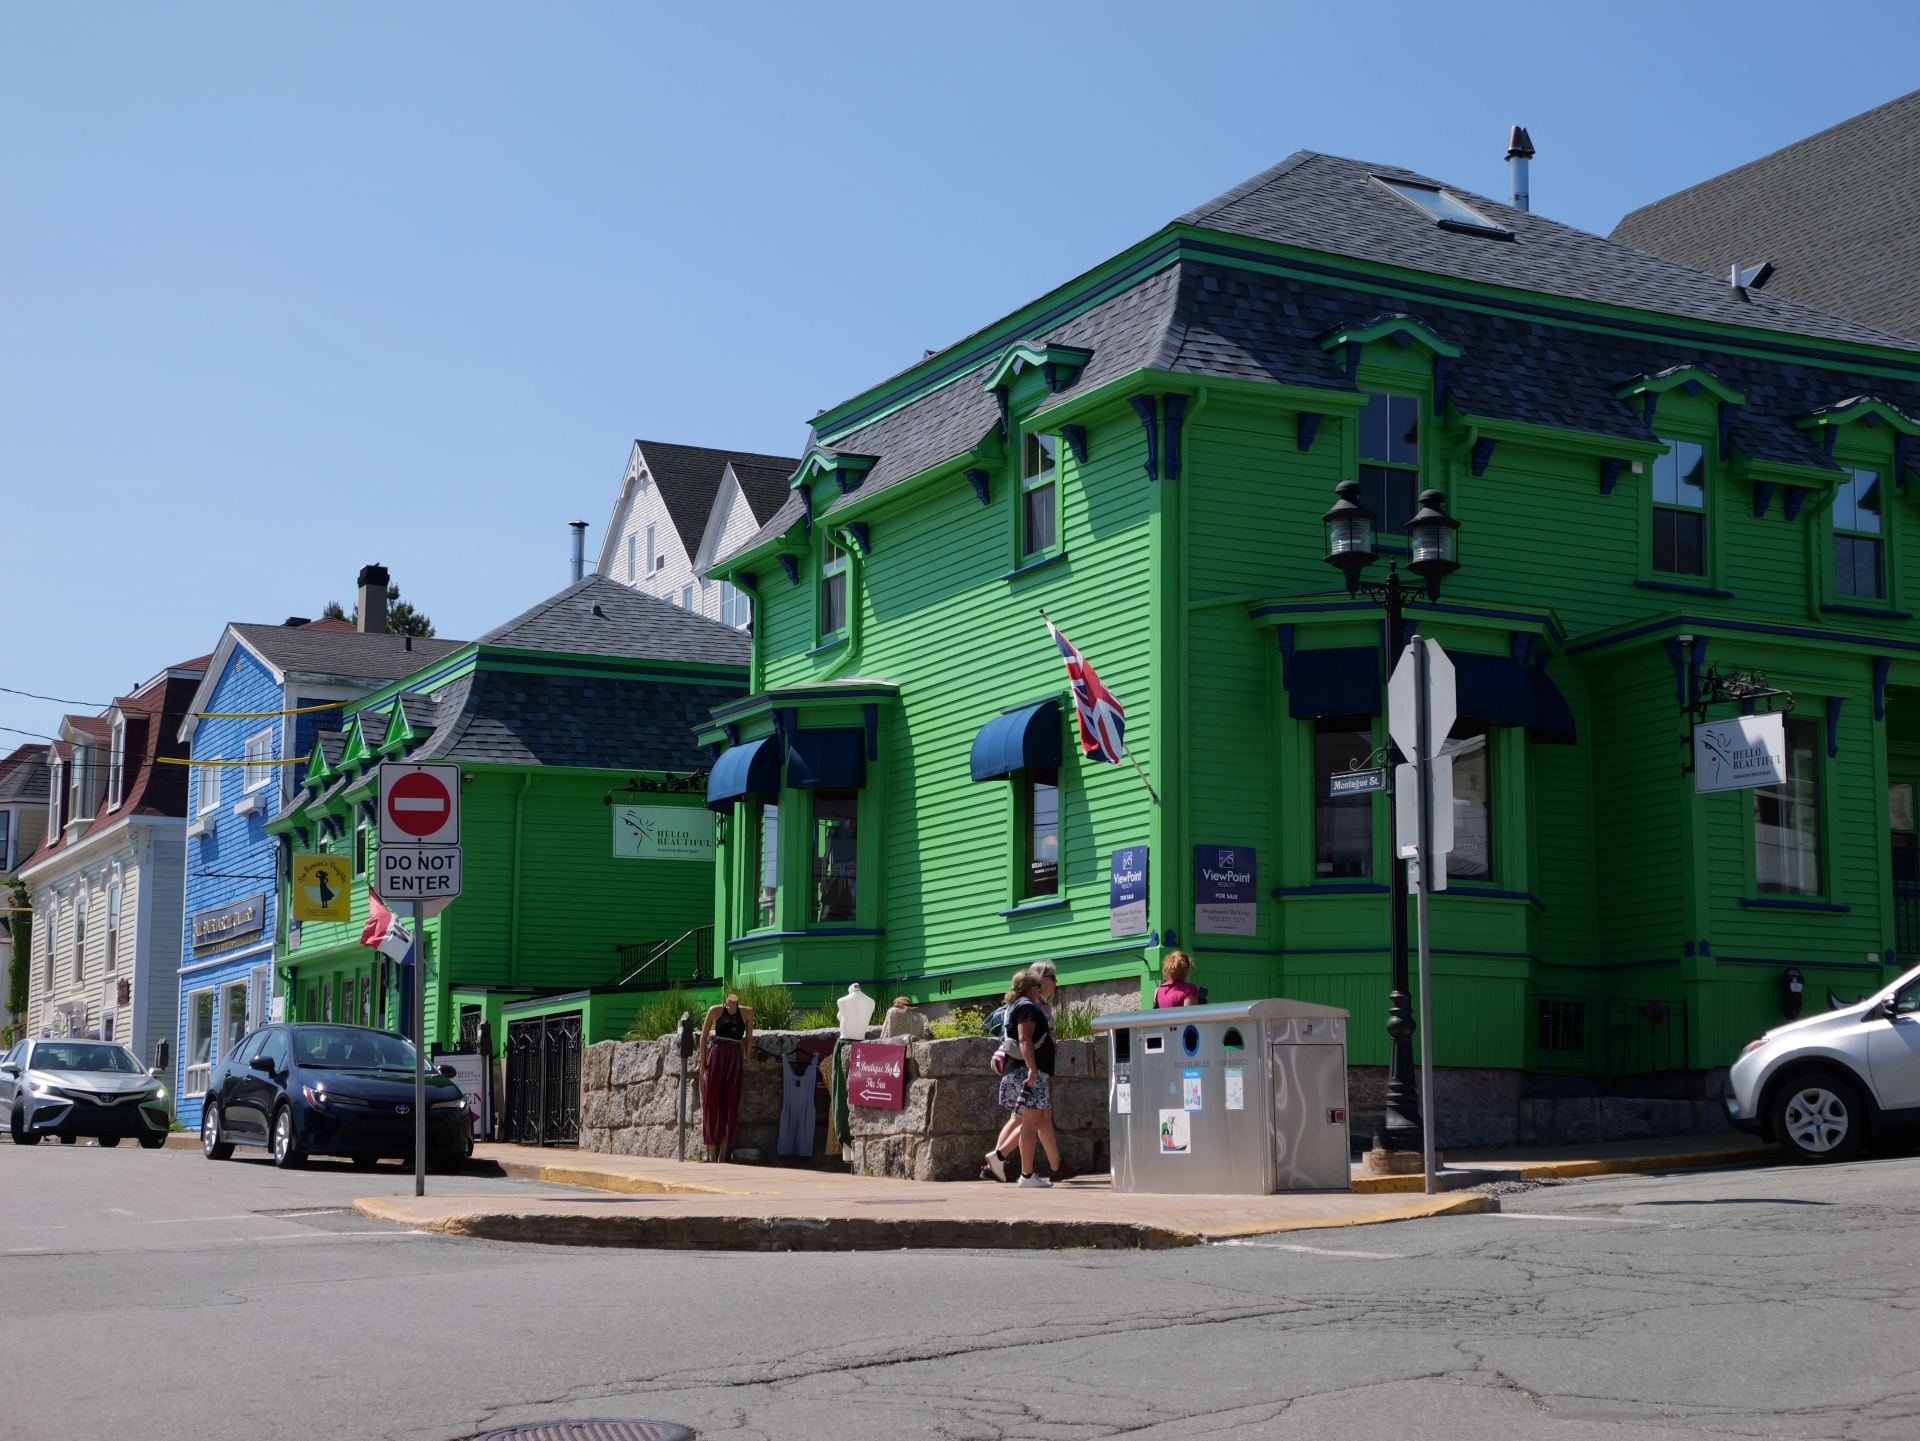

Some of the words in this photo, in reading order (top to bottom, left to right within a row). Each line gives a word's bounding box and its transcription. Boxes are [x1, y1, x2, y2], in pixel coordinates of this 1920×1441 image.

[1733, 747, 1761, 760] HELLO
[1733, 755, 1781, 770] BEAUTIFUL
[1333, 780, 1368, 790] Montague
[1370, 776, 1379, 785] St.
[657, 830, 689, 838] HELLO
[657, 838, 712, 847] BEAUTIFUL
[386, 856, 412, 870] DO
[418, 855, 455, 870] NOT
[390, 875, 450, 890] ENTER
[1113, 870, 1142, 885] ViewPoint
[1203, 868, 1251, 883] ViewPoint
[940, 979, 952, 995] 107
[860, 1060, 884, 1075] Boutique
[884, 1062, 893, 1077] By
[866, 1077, 875, 1088] The
